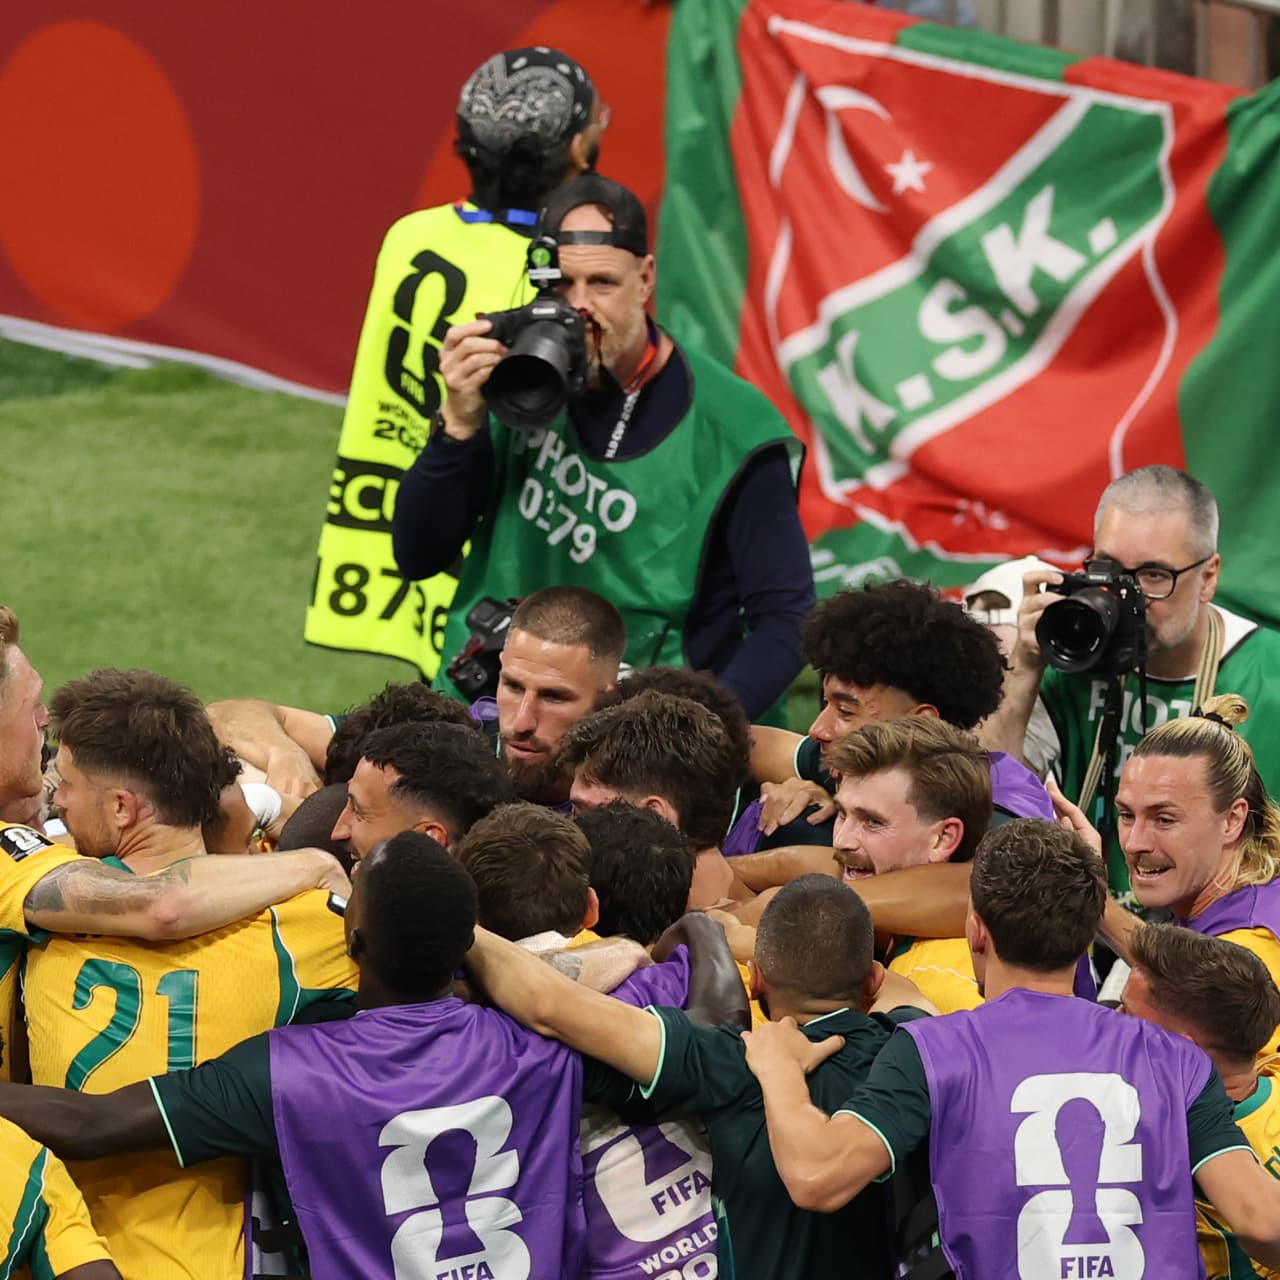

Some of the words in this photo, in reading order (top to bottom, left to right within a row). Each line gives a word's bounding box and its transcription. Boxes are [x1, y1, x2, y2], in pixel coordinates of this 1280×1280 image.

[817, 184, 1118, 453] K.S.K.
[517, 427, 637, 532] PHOTO
[64, 957, 201, 1094] 21
[651, 1169, 712, 1216] FIFA
[638, 1222, 718, 1274] WORLD
[1061, 1255, 1115, 1279] FIFA
